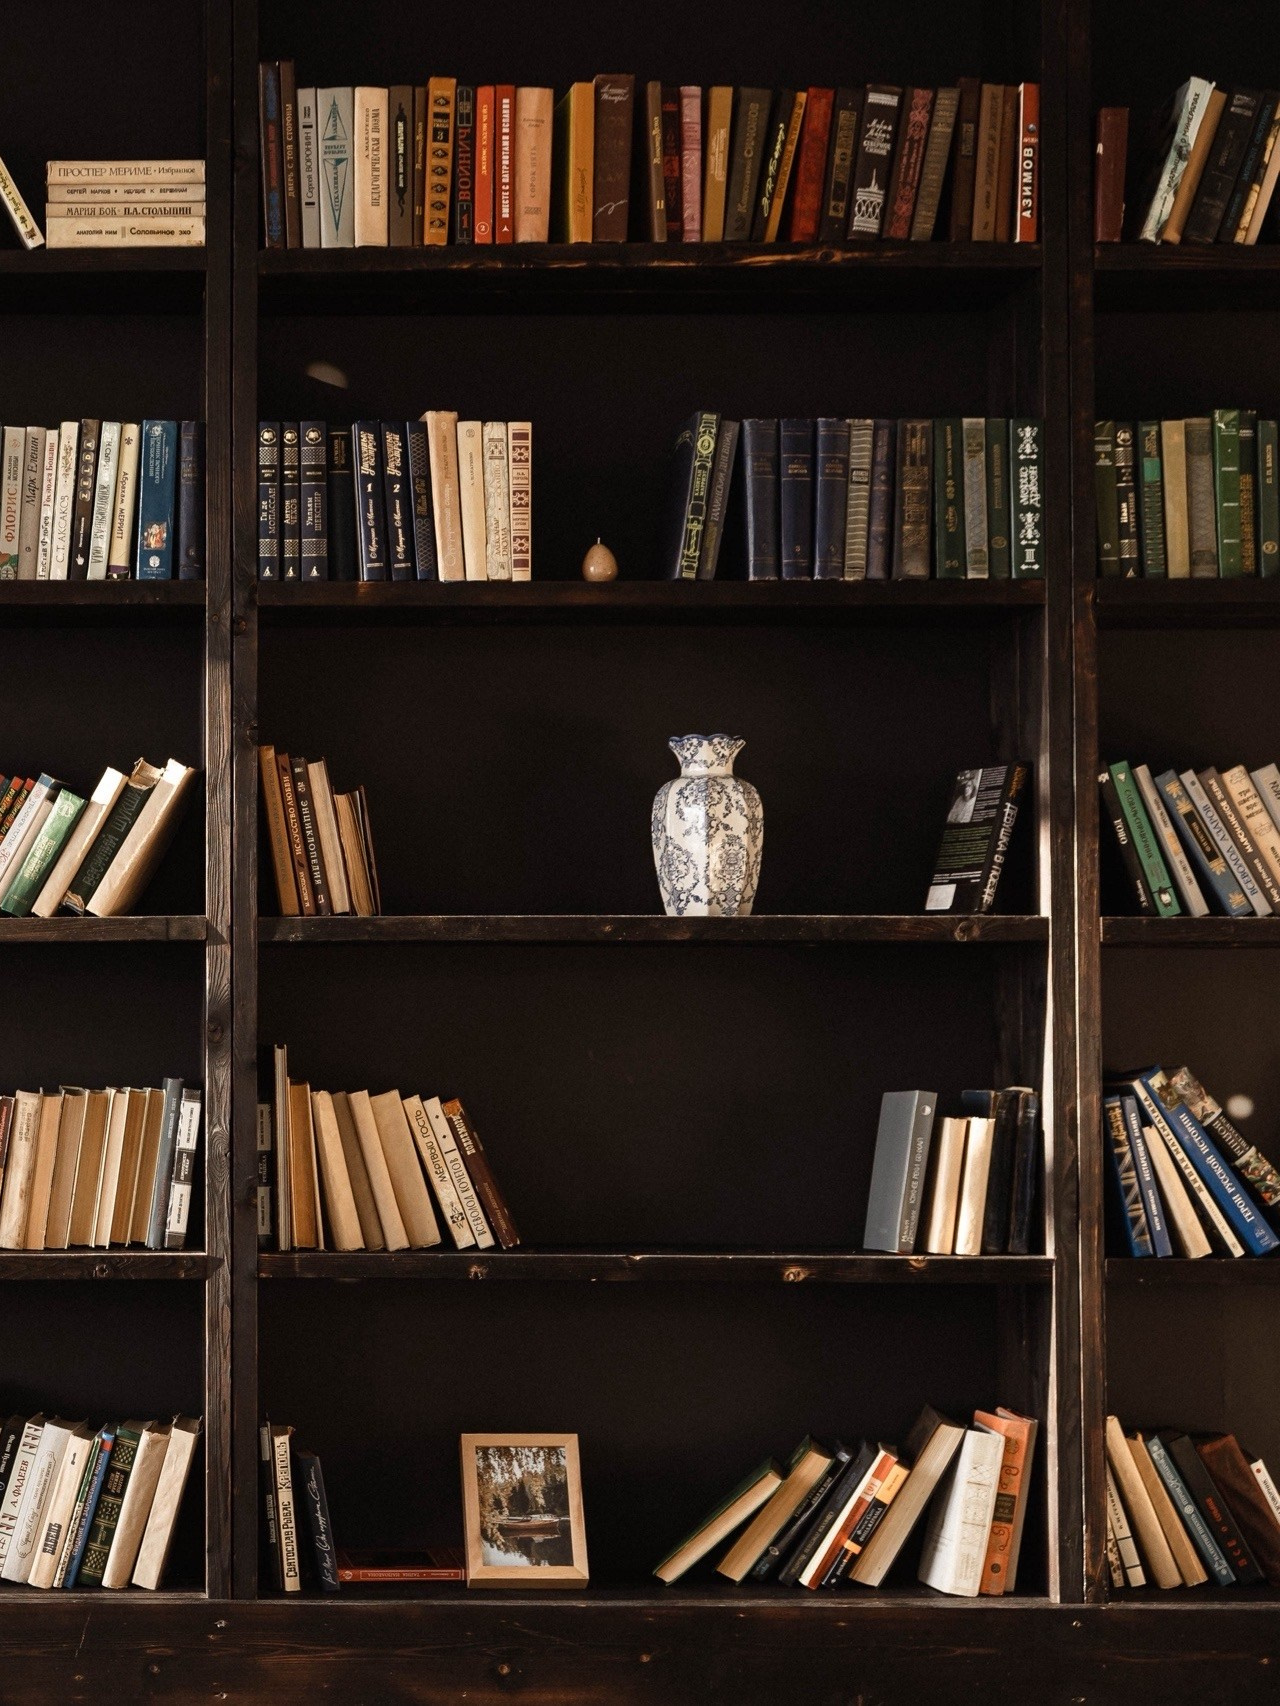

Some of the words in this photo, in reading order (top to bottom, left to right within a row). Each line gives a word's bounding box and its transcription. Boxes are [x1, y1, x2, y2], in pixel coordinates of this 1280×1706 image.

[286, 103, 294, 140] СТОРОНЫ
[371, 108, 380, 133] ПОЭМА
[502, 98, 510, 133] ИСПАНИИ
[304, 132, 313, 172] ВОРОНИН
[502, 135, 510, 183] ПАТРИОТАМИ
[58, 168, 106, 177] ПРОСПЕР
[109, 167, 152, 176] МЕРИМЕ
[158, 167, 196, 175] Избранное
[288, 172, 296, 197] ДВЕРЬ
[306, 174, 315, 198] Сергей
[371, 137, 380, 207] ПЕДАГОГИЧЕСКАЯ
[1022, 147, 1033, 218] АЗИМОВ
[66, 207, 95, 215] МАРИЯ
[99, 207, 117, 215] БОК
[501, 191, 510, 218] ВМЕСТЕ
[130, 227, 175, 236] Соловьиное
[26, 436, 39, 473] Еленин
[45, 442, 55, 471] Бовари
[25, 477, 38, 506] Марк
[43, 472, 52, 507] Госпожа
[119, 472, 128, 504] Абрахам
[1029, 465, 1041, 508] Дрюон
[4, 487, 18, 542] ФЛОРИС
[261, 501, 268, 510] де
[261, 512, 268, 521] Ги
[314, 491, 322, 531] ШЕКСПИР
[116, 508, 124, 539] МЕРРИТТ
[1207, 777, 1225, 799] ЗЕЛЬЕ
[1114, 818, 1128, 845] ОВОД
[1202, 804, 1229, 842] АЗАРОВ
[1219, 800, 1254, 853] МАРСИАНСКОЕ
[300, 800, 322, 885] ЭНЦИКЛОПЕДИЯ
[1226, 845, 1258, 896] ВСЕВОЛОД
[1253, 858, 1273, 886] Булычев
[1130, 1112, 1141, 1136] ПАМЯТЬ
[1143, 1095, 1182, 1155] МАТЕМАТИКА
[1179, 1112, 1210, 1153] ИСТОРИИ
[449, 1157, 470, 1193] КОЧЕТОВ
[1135, 1138, 1152, 1181] НЕСТАРЕЮЩАЯ
[1205, 1154, 1236, 1193] РУССКОЙ
[465, 1194, 487, 1236] ВСЕВОЛОД
[1232, 1193, 1256, 1222] ГЕРОИ
[12, 1460, 30, 1497] ФАДЕЕВ
[79, 1517, 87, 1526] НА
[83, 1475, 99, 1516] ЗАБРОШЕННОЙ
[93, 1452, 105, 1474] МОГИЛЕ
[10, 1497, 18, 1508] А.
[42, 1522, 62, 1555] БАБЕЛЬ
